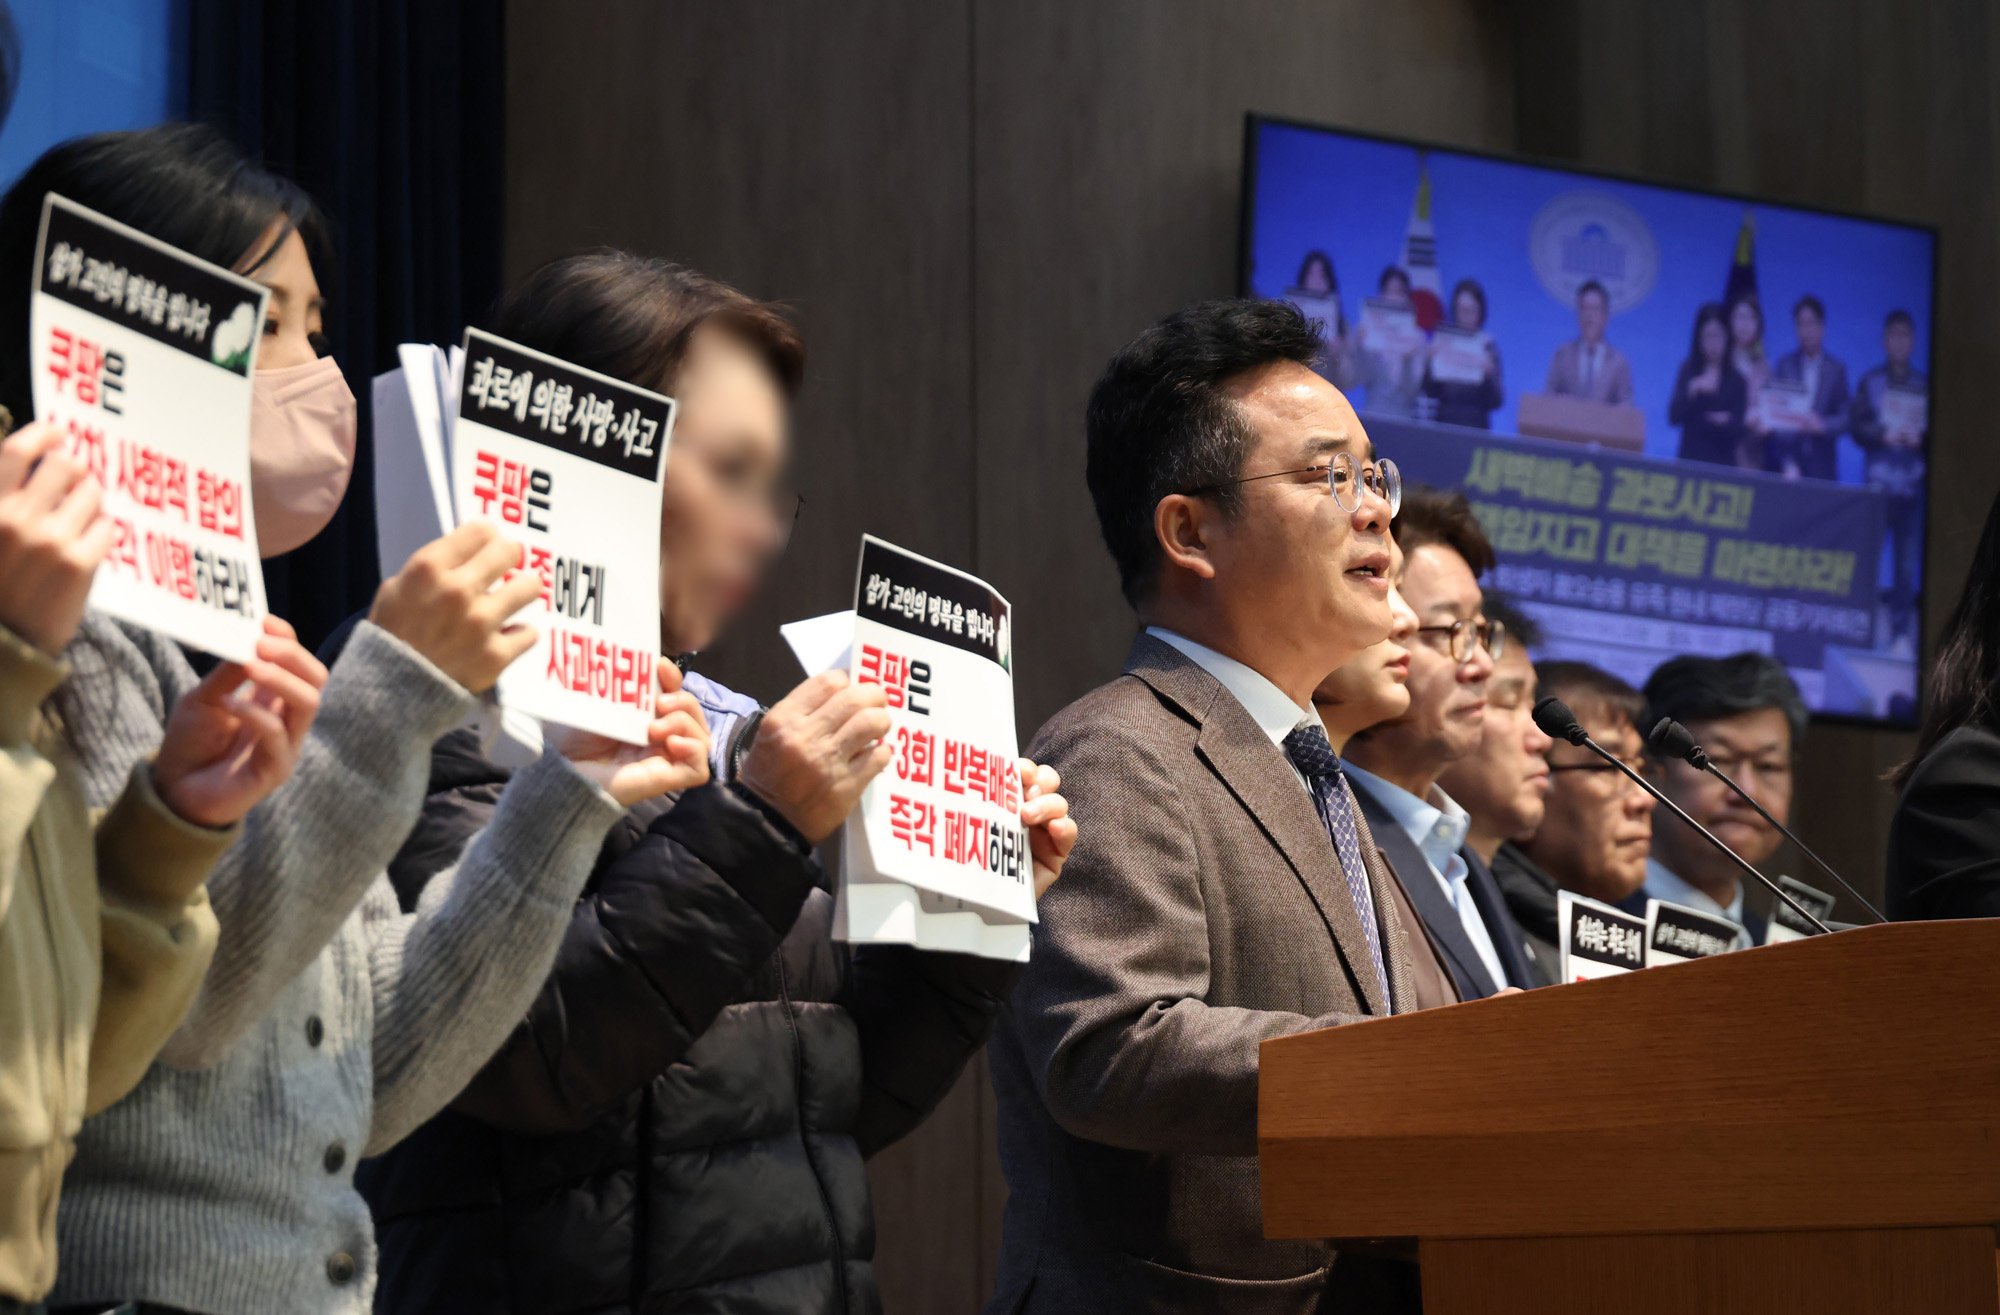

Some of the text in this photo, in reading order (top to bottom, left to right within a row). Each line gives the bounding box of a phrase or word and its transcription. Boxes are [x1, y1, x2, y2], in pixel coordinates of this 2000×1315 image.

[48, 327, 127, 416] 쿠팡은
[468, 357, 533, 422] 과로에
[531, 378, 574, 434] 의한
[118, 438, 190, 523] 사회적
[197, 468, 244, 542] 합의
[472, 449, 553, 533] 쿠팡은
[105, 517, 142, 581] 각
[503, 542, 605, 626] 족에게
[866, 573, 995, 647] 삼가 고인의 명복을 빕니다
[547, 627, 653, 712] 사과하라!
[944, 738, 1018, 815] 반복배송
[890, 793, 1025, 885] 즉각 폐지하라!
